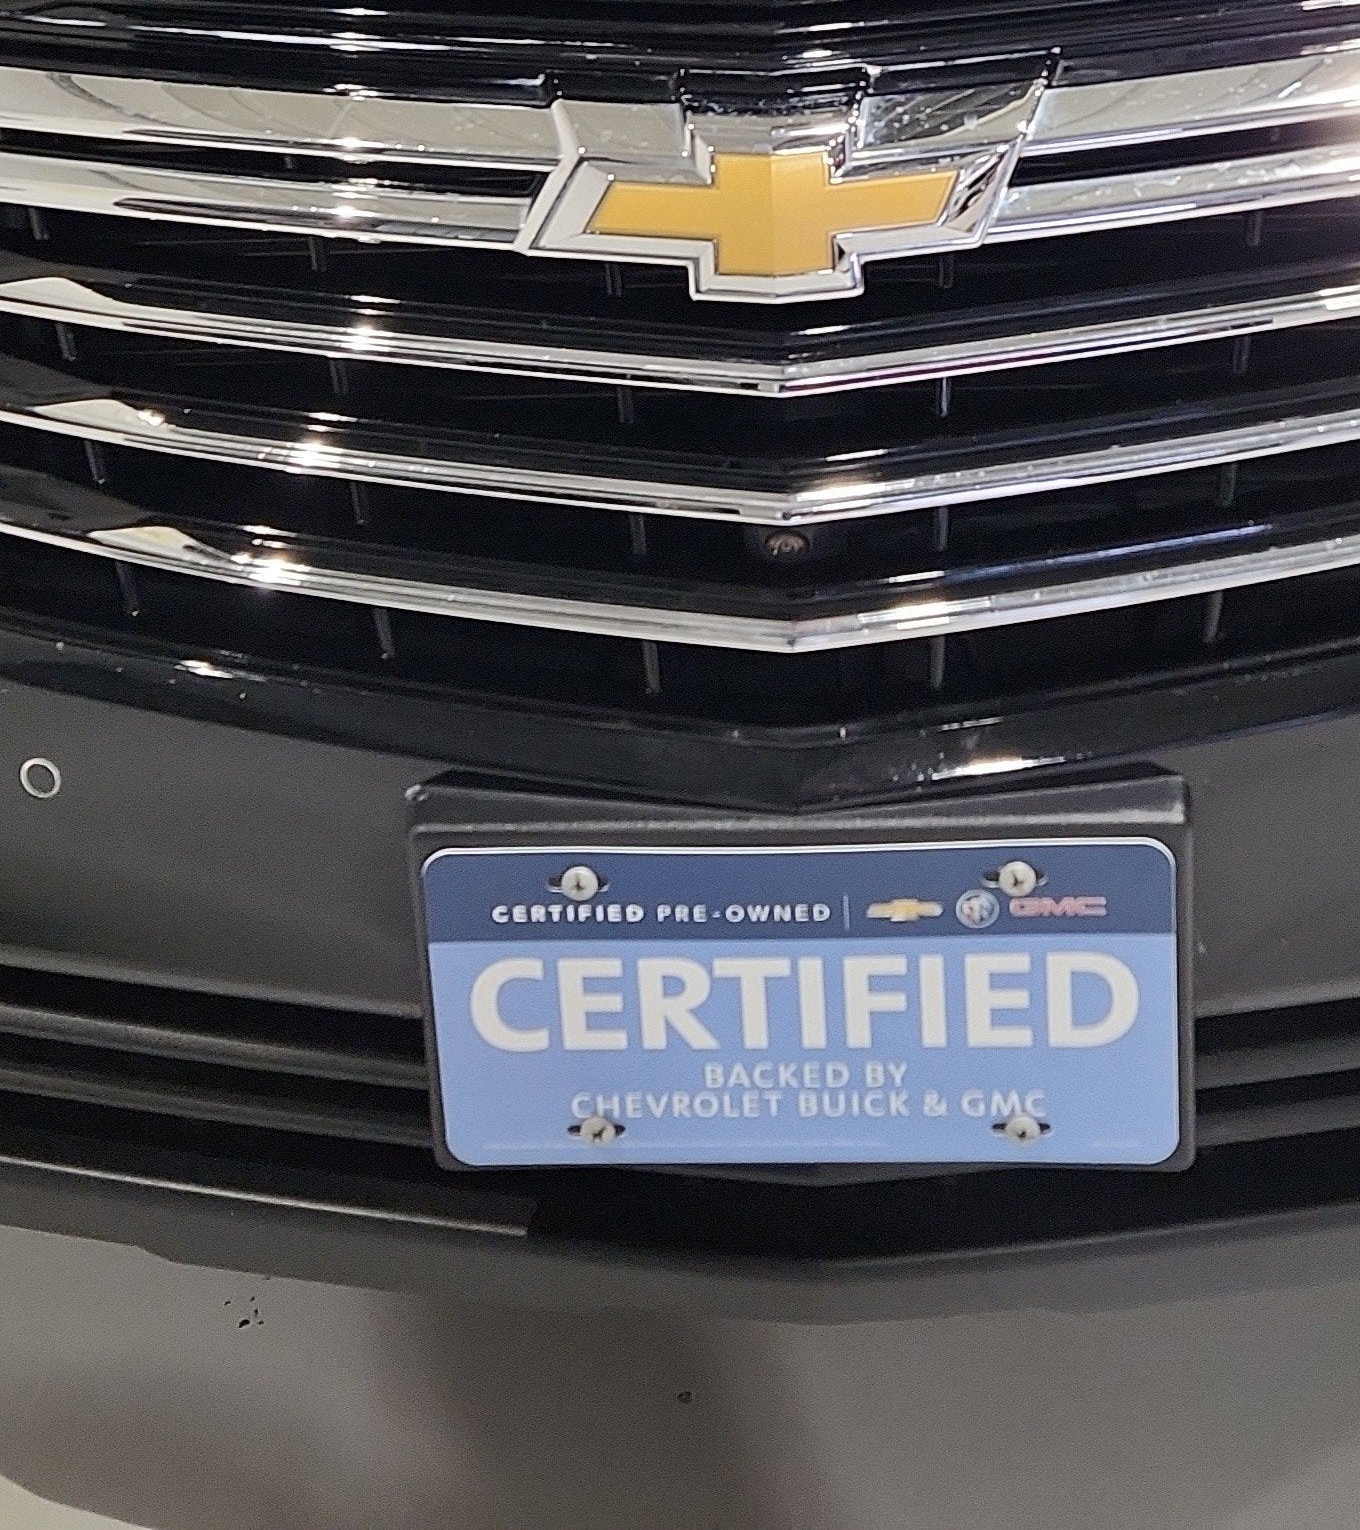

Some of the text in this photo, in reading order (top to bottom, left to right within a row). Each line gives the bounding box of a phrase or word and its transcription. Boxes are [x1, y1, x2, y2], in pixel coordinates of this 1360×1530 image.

[491, 903, 831, 923] CERTIFIED PRE-OWNED
[1009, 896, 1108, 917] GMC
[470, 953, 1140, 1052] CERTIFIED
[703, 1061, 908, 1090] BACKED BY
[571, 1089, 1047, 1119] CHEVROLET BUICK & GMC
